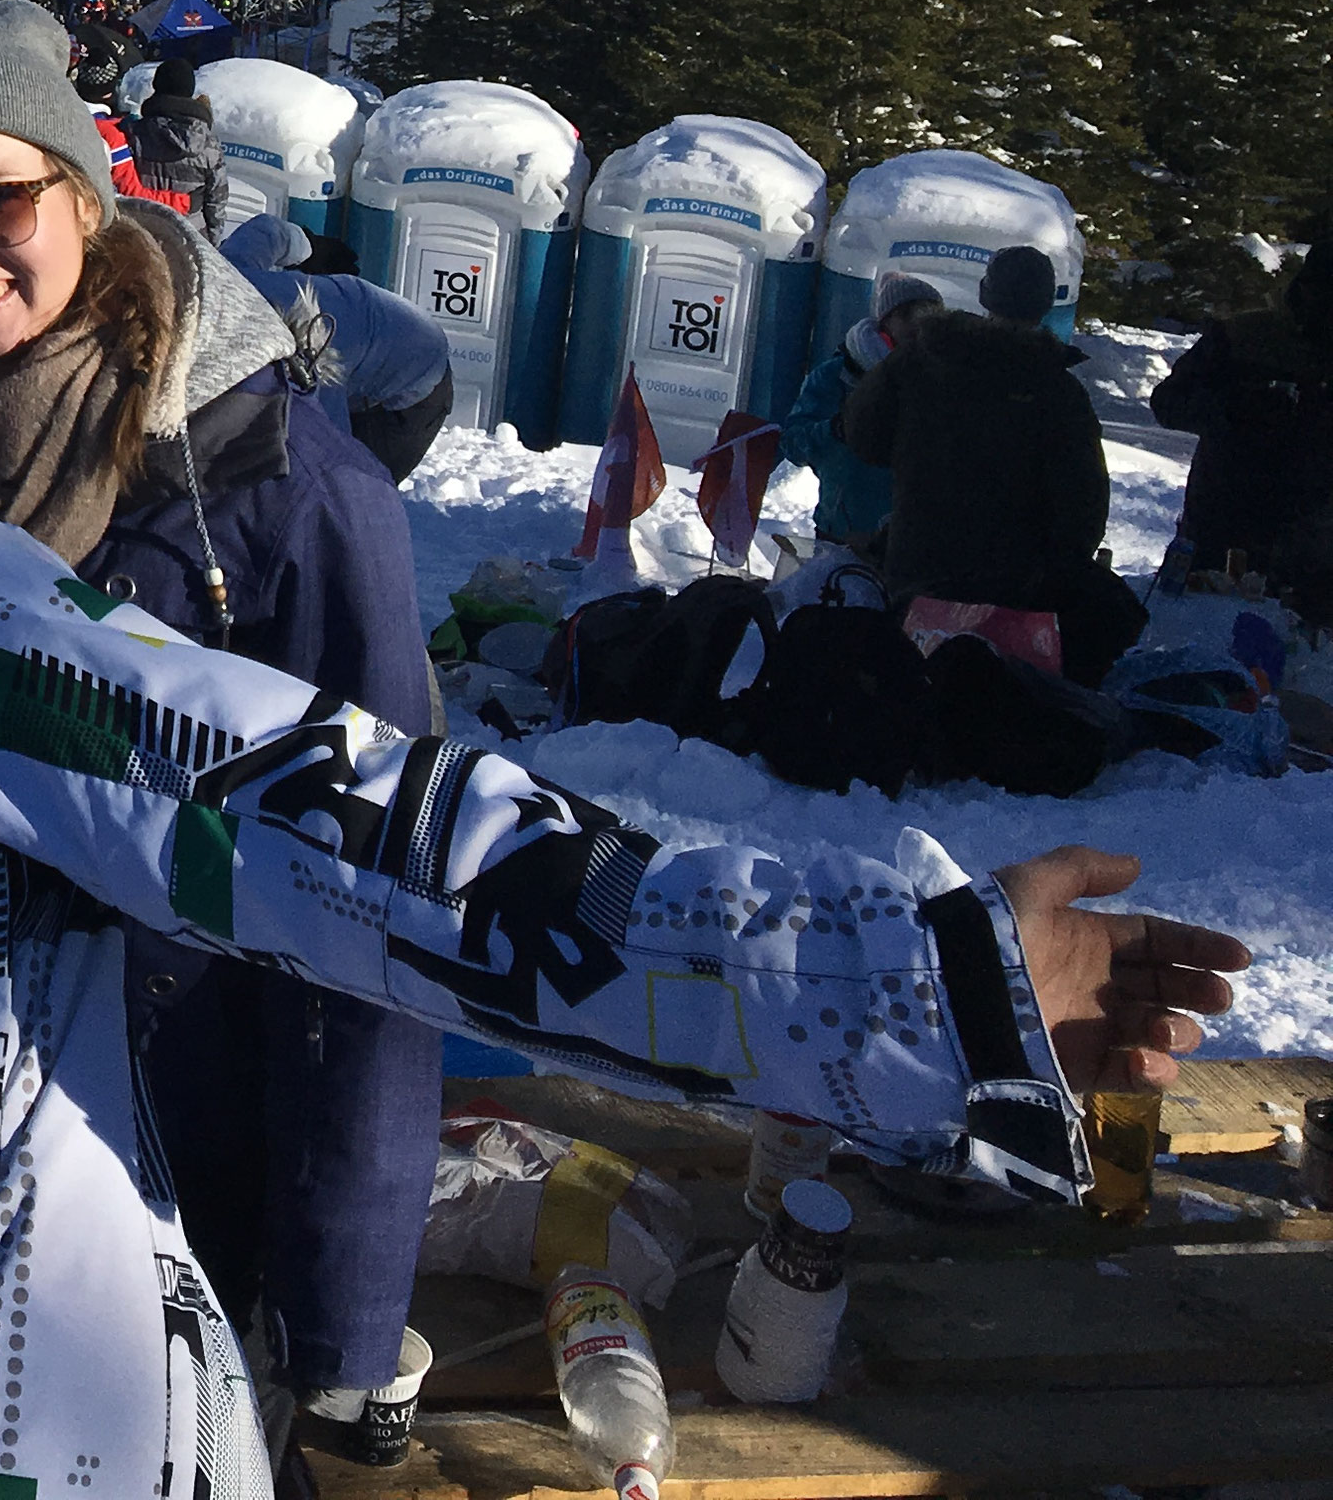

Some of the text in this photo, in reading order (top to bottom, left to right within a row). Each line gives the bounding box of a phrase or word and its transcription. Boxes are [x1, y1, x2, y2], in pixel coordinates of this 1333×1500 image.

[938, 245, 990, 263] Origina
[431, 292, 476, 317] TOI
[669, 323, 718, 353] TOI
[646, 379, 729, 403] 0800 864 000
